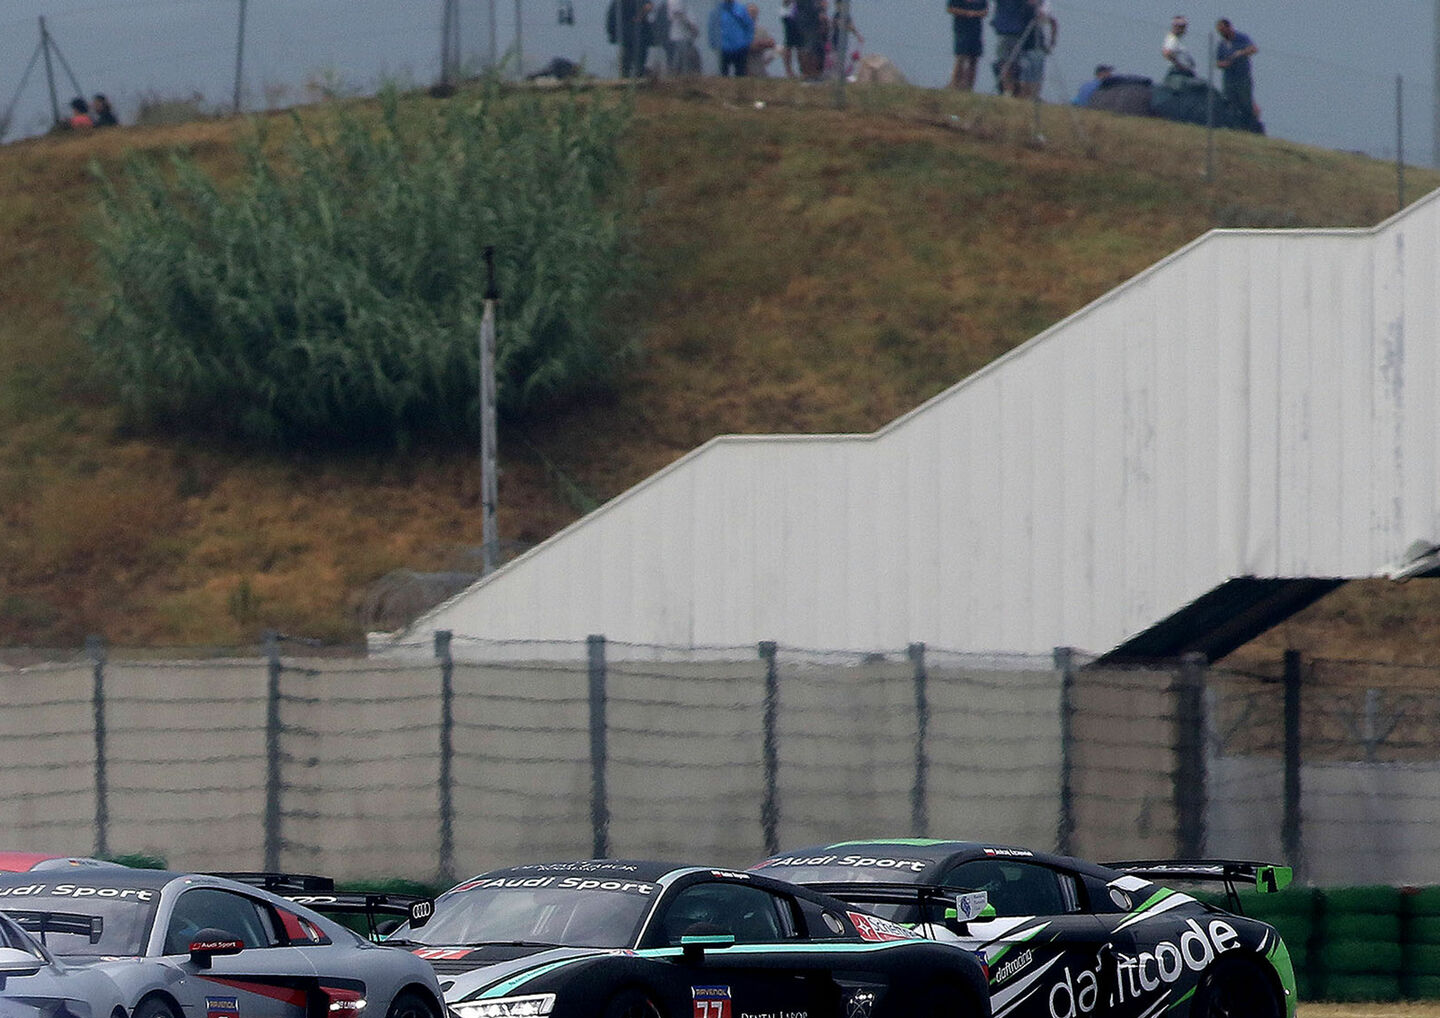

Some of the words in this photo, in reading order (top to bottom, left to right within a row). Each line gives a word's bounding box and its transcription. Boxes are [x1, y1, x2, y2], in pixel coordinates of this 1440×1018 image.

[773, 856, 837, 867] Audi
[838, 855, 926, 872] Sport
[50, 884, 153, 901] Sport
[481, 876, 555, 889] Audi
[558, 876, 654, 896] Sport
[418, 949, 461, 960] 77
[995, 949, 1033, 983] daftracing
